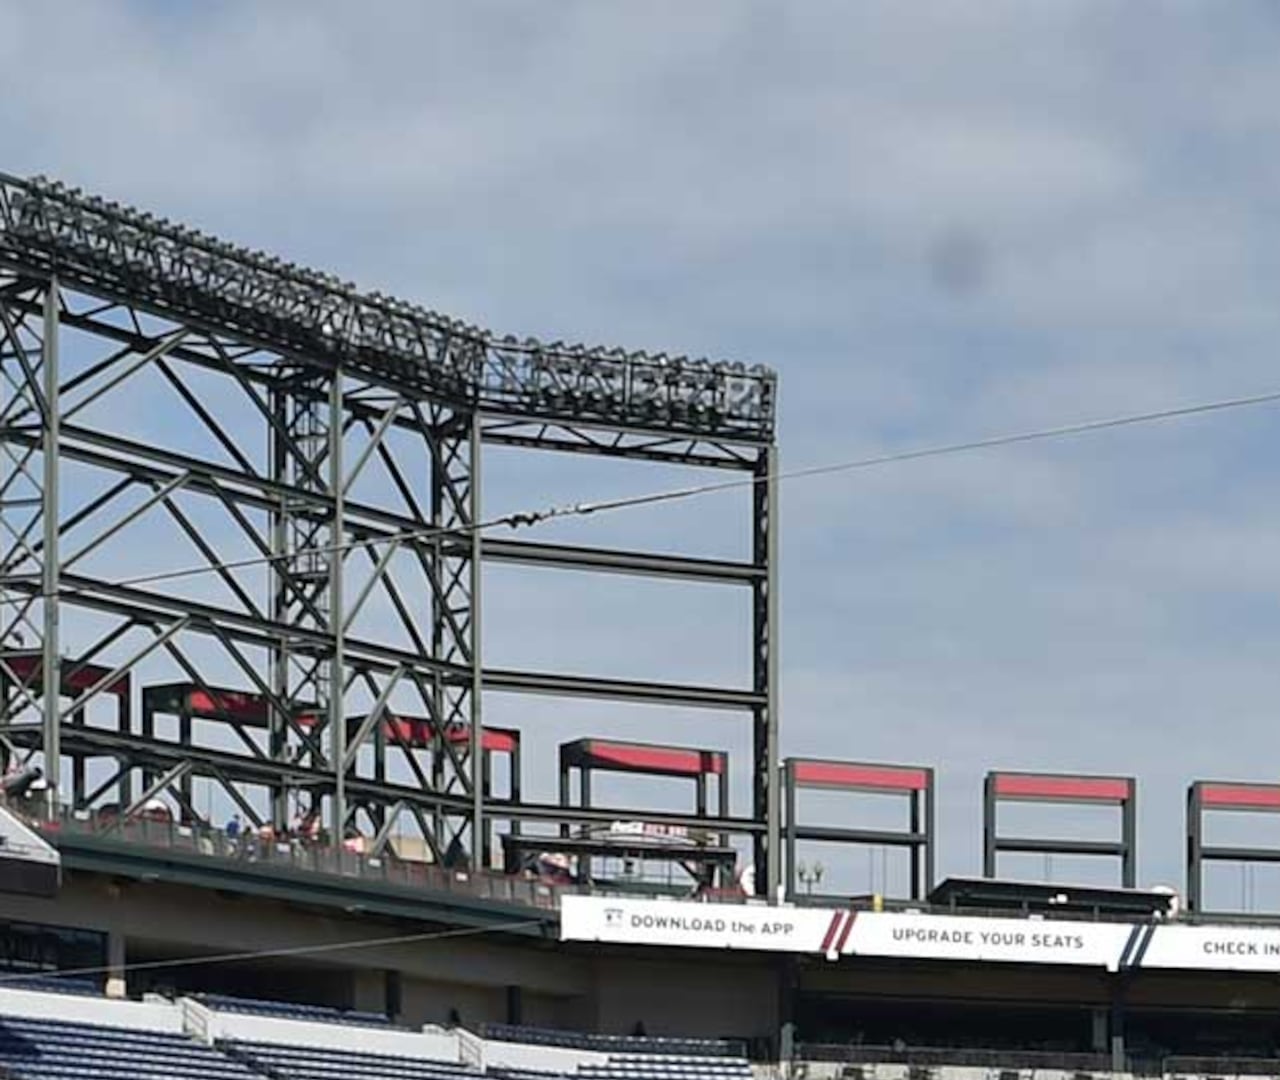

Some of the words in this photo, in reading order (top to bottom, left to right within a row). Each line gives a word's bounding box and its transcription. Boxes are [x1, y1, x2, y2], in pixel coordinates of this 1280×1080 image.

[630, 914, 726, 933] DOWNLOAD
[731, 921, 756, 934] the
[760, 922, 795, 935] APP
[892, 927, 975, 945] UPGRADE
[979, 931, 1026, 946] YOUR
[1030, 934, 1085, 949] SEATS
[1202, 941, 1259, 956] CHECK
[1263, 943, 1280, 956] IN
